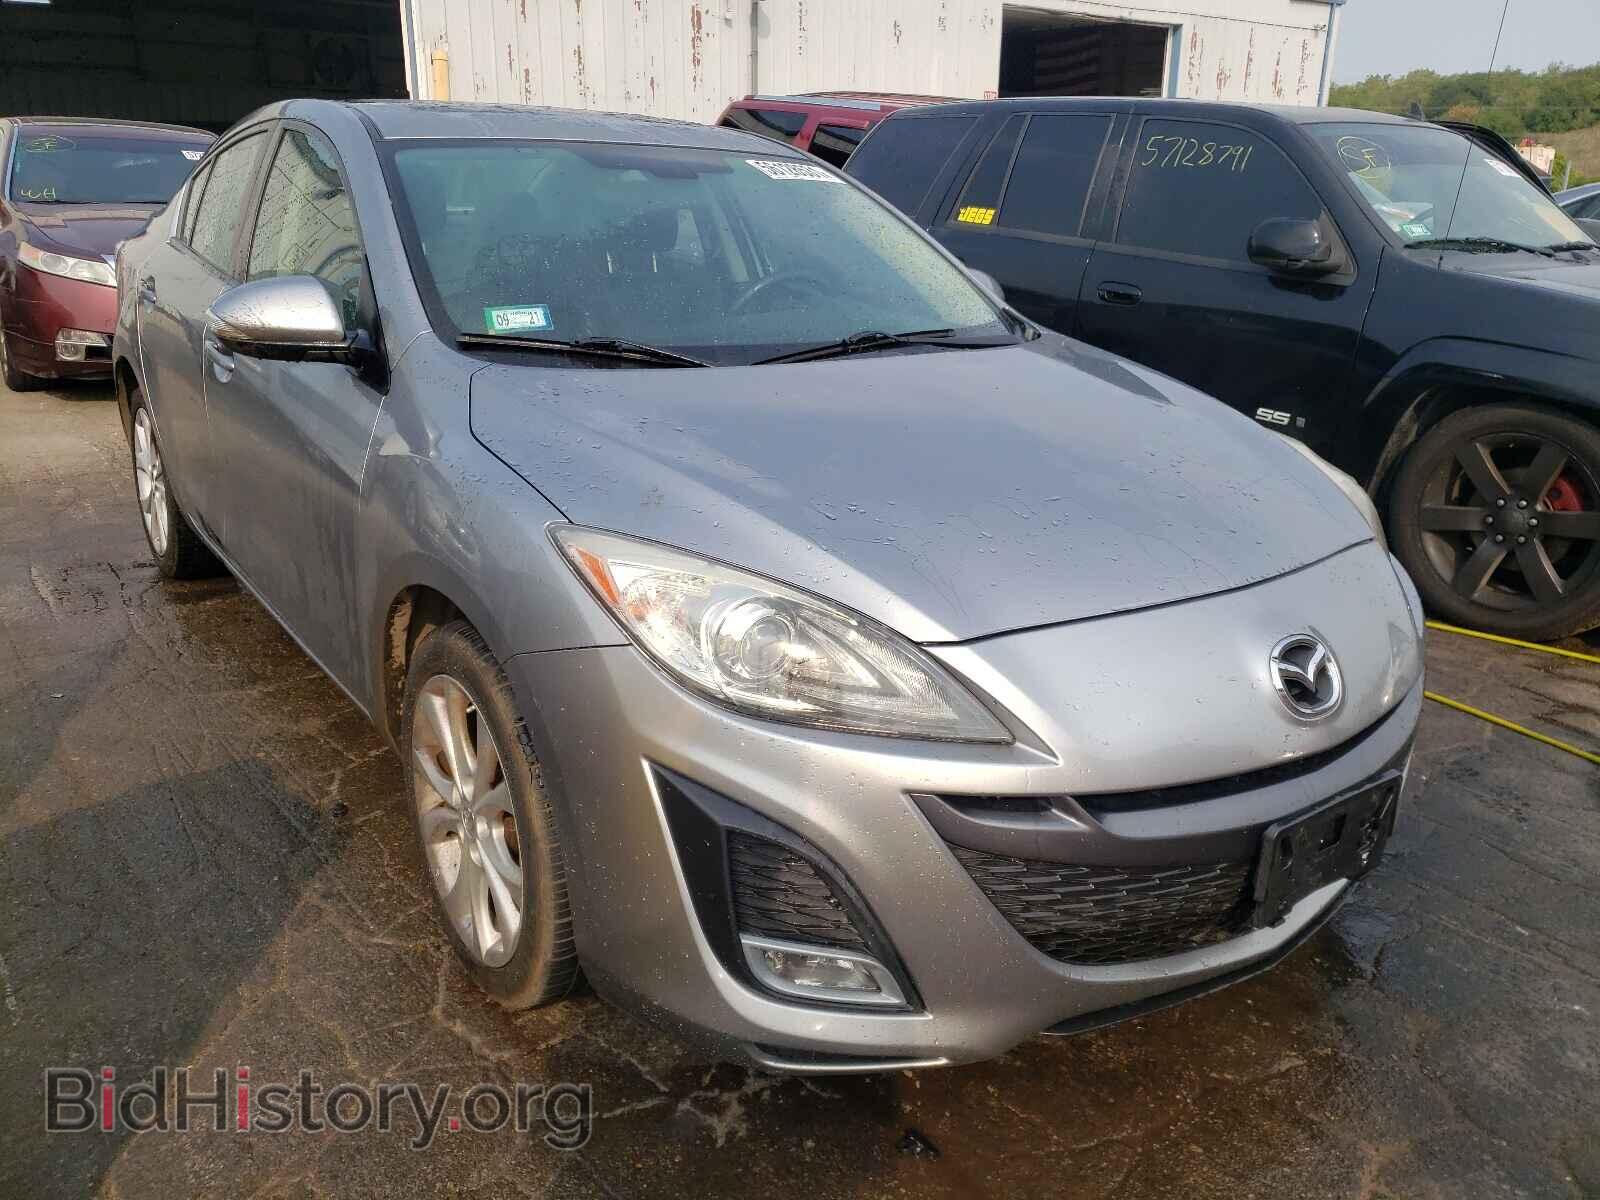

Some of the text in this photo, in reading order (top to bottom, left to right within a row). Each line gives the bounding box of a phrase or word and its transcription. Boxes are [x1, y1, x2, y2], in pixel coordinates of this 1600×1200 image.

[1141, 135, 1253, 172] 57128791
[957, 205, 996, 225] JEGS
[1254, 407, 1291, 425] SS
